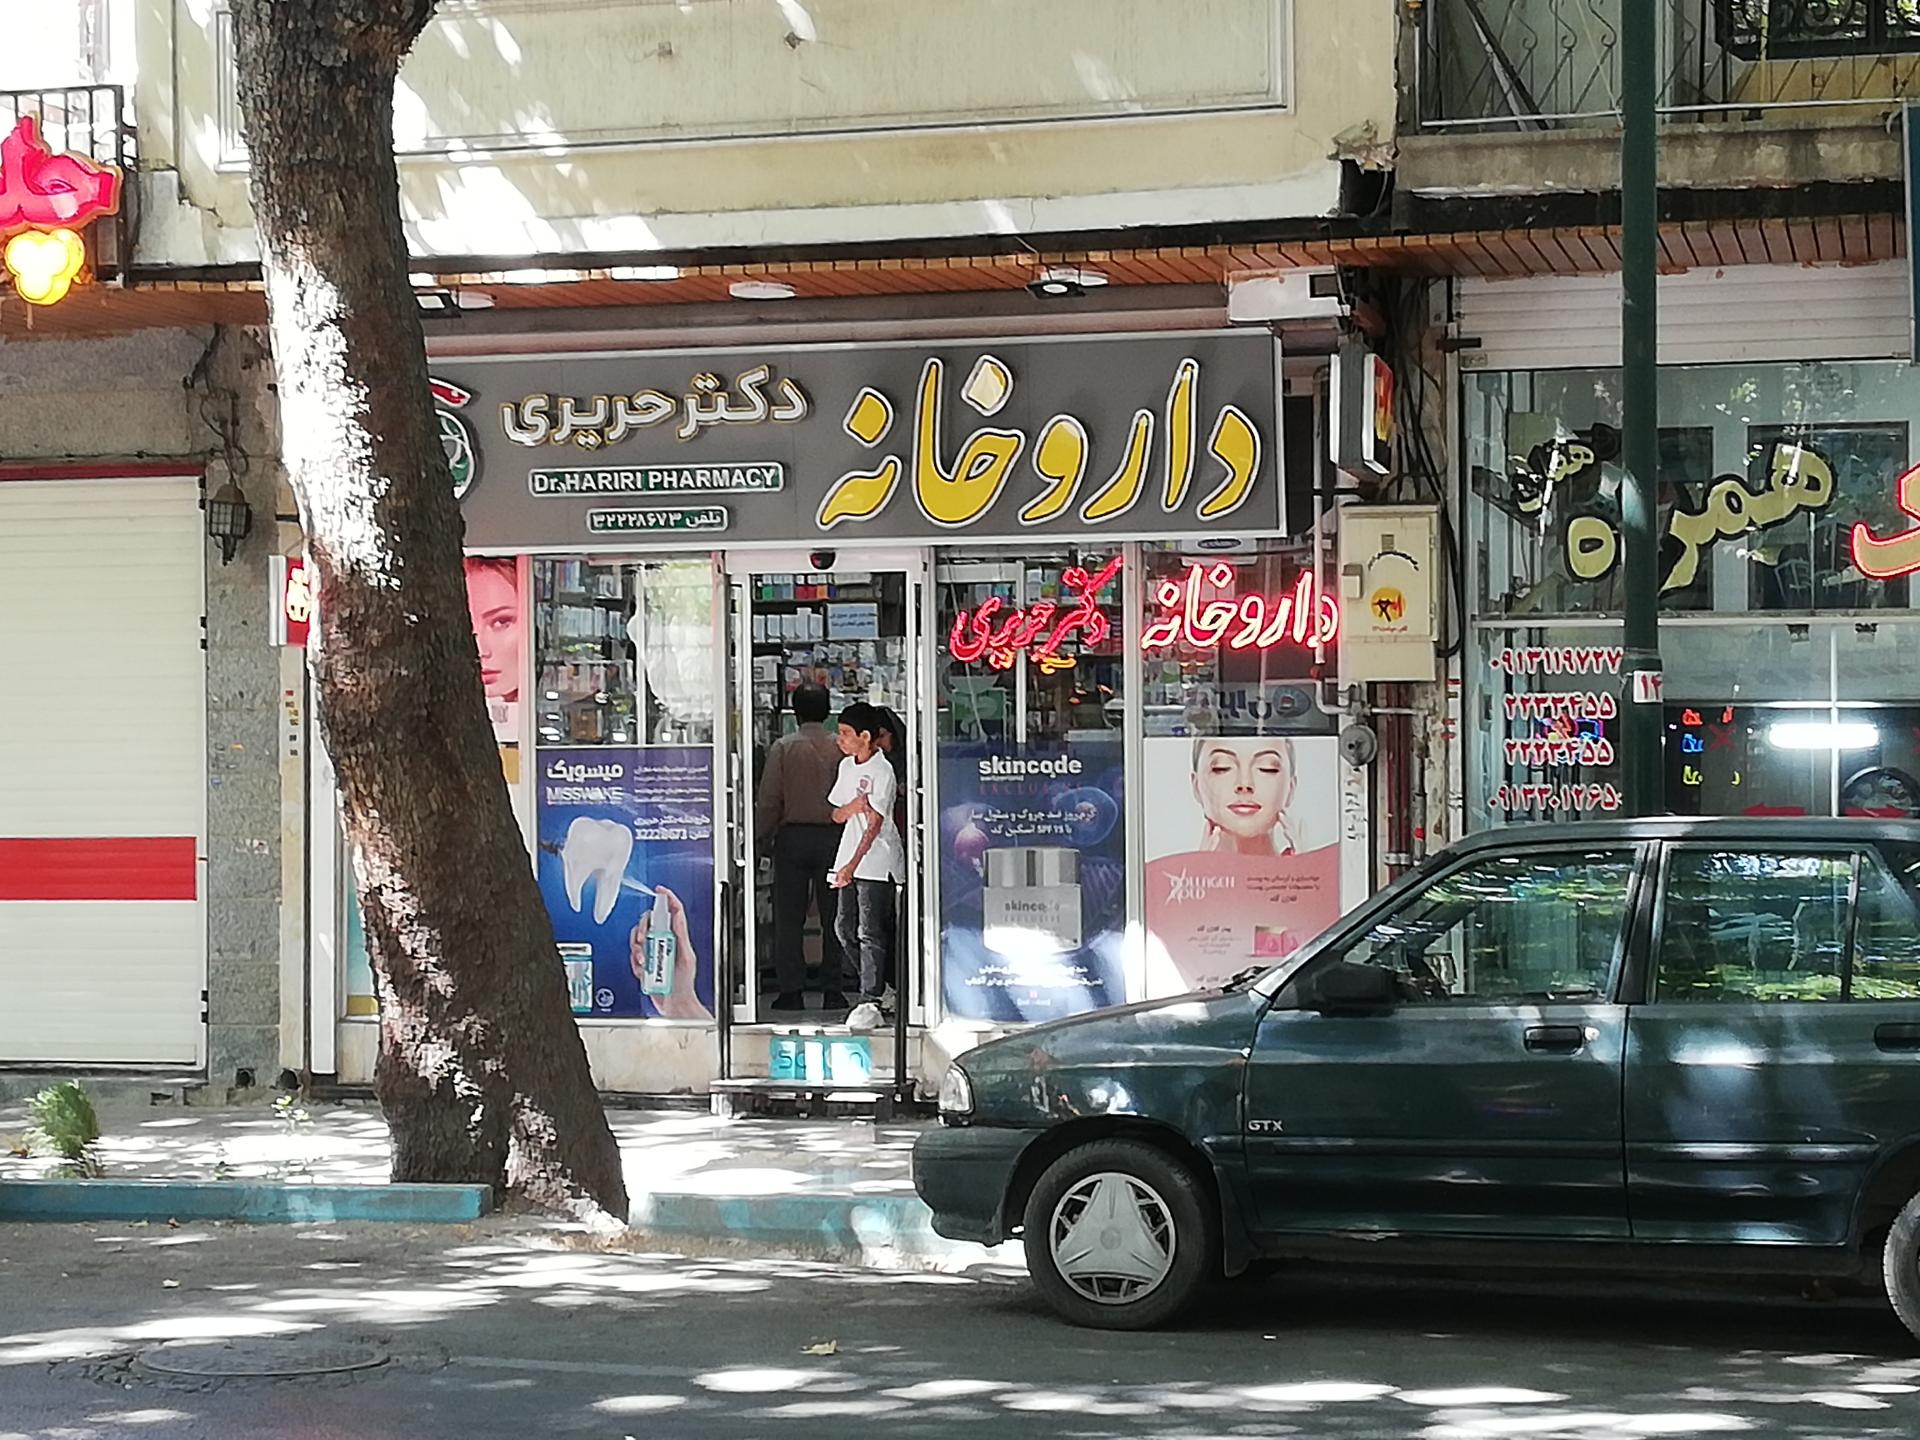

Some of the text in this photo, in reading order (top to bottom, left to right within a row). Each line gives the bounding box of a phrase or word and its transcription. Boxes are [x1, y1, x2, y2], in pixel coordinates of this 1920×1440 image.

[502, 364, 810, 451] دکتر حریری
[816, 355, 1262, 531] داروخانه
[649, 468, 776, 490] PHARMACY
[685, 510, 721, 527] تلفن
[1141, 561, 1340, 650] داروخانه
[547, 759, 624, 783] میسویک
[978, 754, 1083, 778] skincode
[1489, 784, 1623, 811] ۰۹۱۳۳۰۱۲۶۵
[1248, 1120, 1283, 1131] GTX
